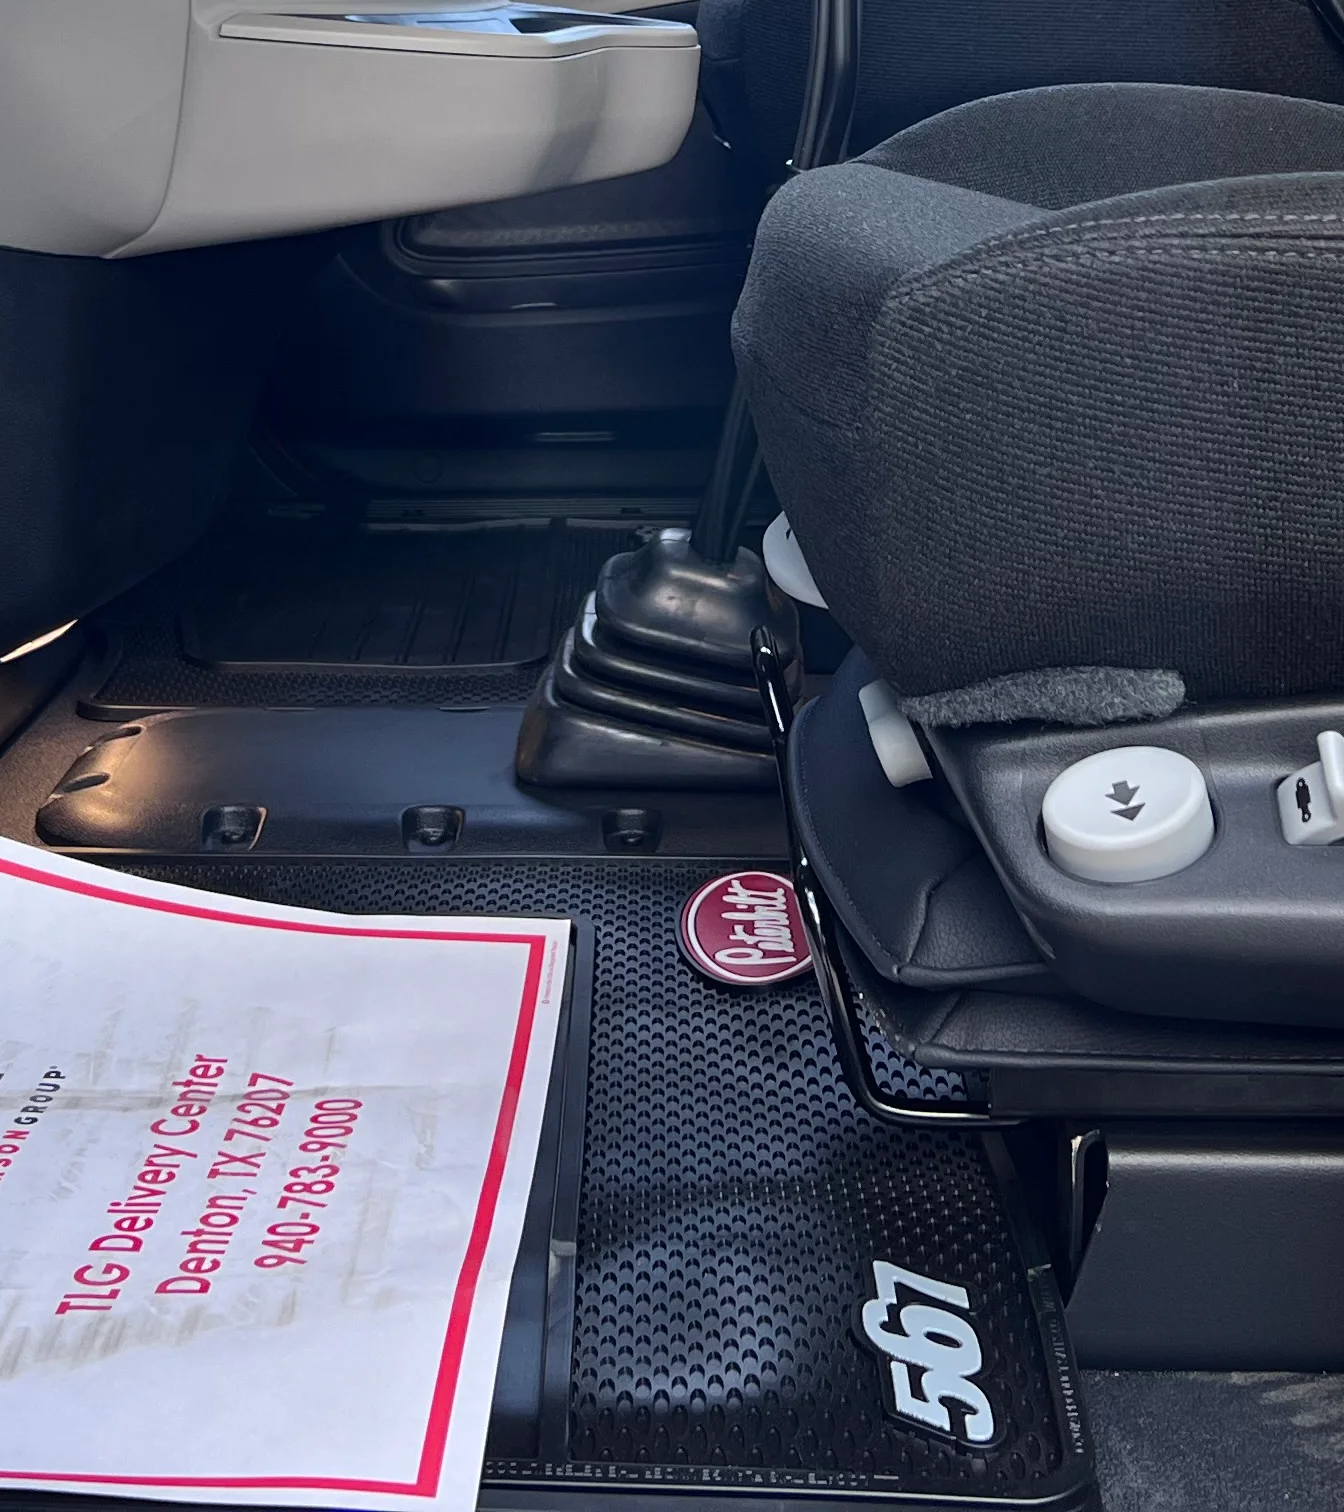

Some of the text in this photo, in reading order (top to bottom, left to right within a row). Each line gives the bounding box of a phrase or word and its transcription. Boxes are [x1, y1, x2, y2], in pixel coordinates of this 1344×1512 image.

[714, 878, 798, 965] Peterbilt
[56, 1054, 228, 1315] TLG Delivery Center
[154, 1072, 294, 1294] Denton, TX 76207
[254, 1099, 363, 1268] 940-783-9000
[862, 1260, 995, 1443] 567
